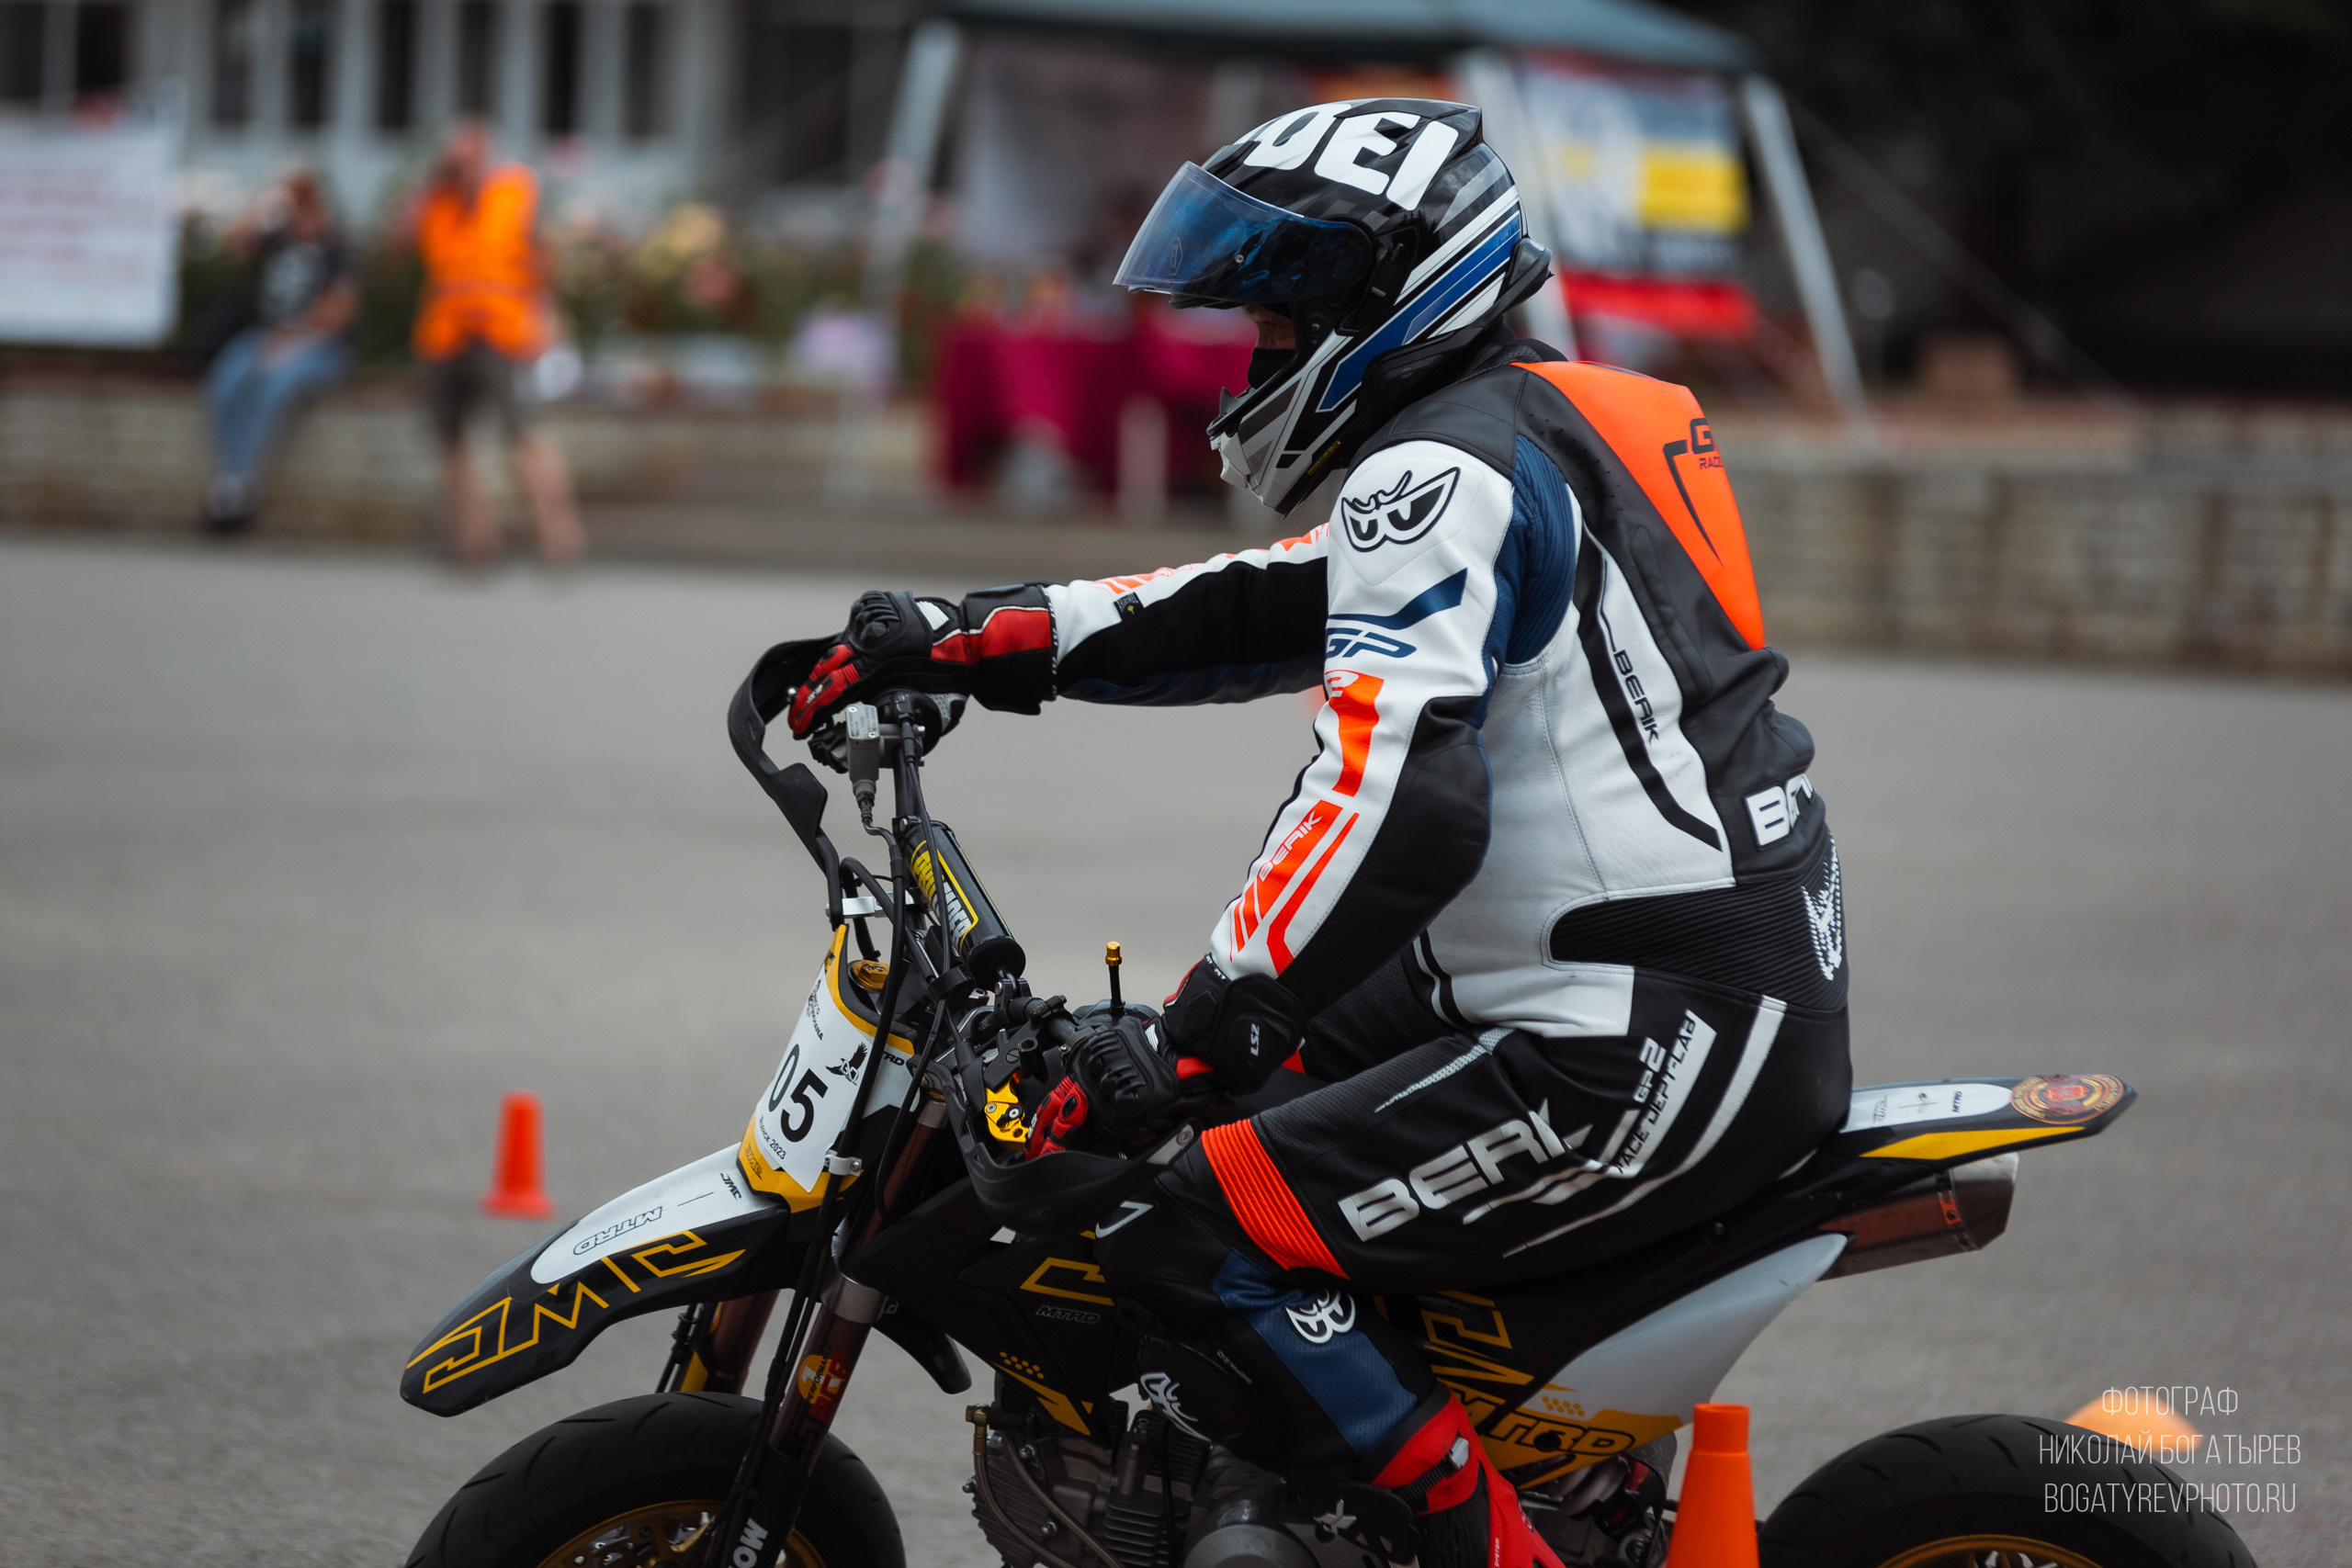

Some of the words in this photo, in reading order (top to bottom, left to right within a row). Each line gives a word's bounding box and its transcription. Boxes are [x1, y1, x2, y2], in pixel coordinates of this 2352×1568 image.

[1236, 104, 1459, 211] OEI
[1613, 650, 1661, 745] BERIK
[1259, 810, 1323, 883] BERIK
[883, 1051, 905, 1066] RD
[1632, 1037, 1667, 1103] GP2
[770, 1139, 786, 1160] 2023
[719, 1172, 742, 1201] JMC
[573, 1205, 663, 1256] MTRD
[1035, 1304, 1102, 1325] MTRD
